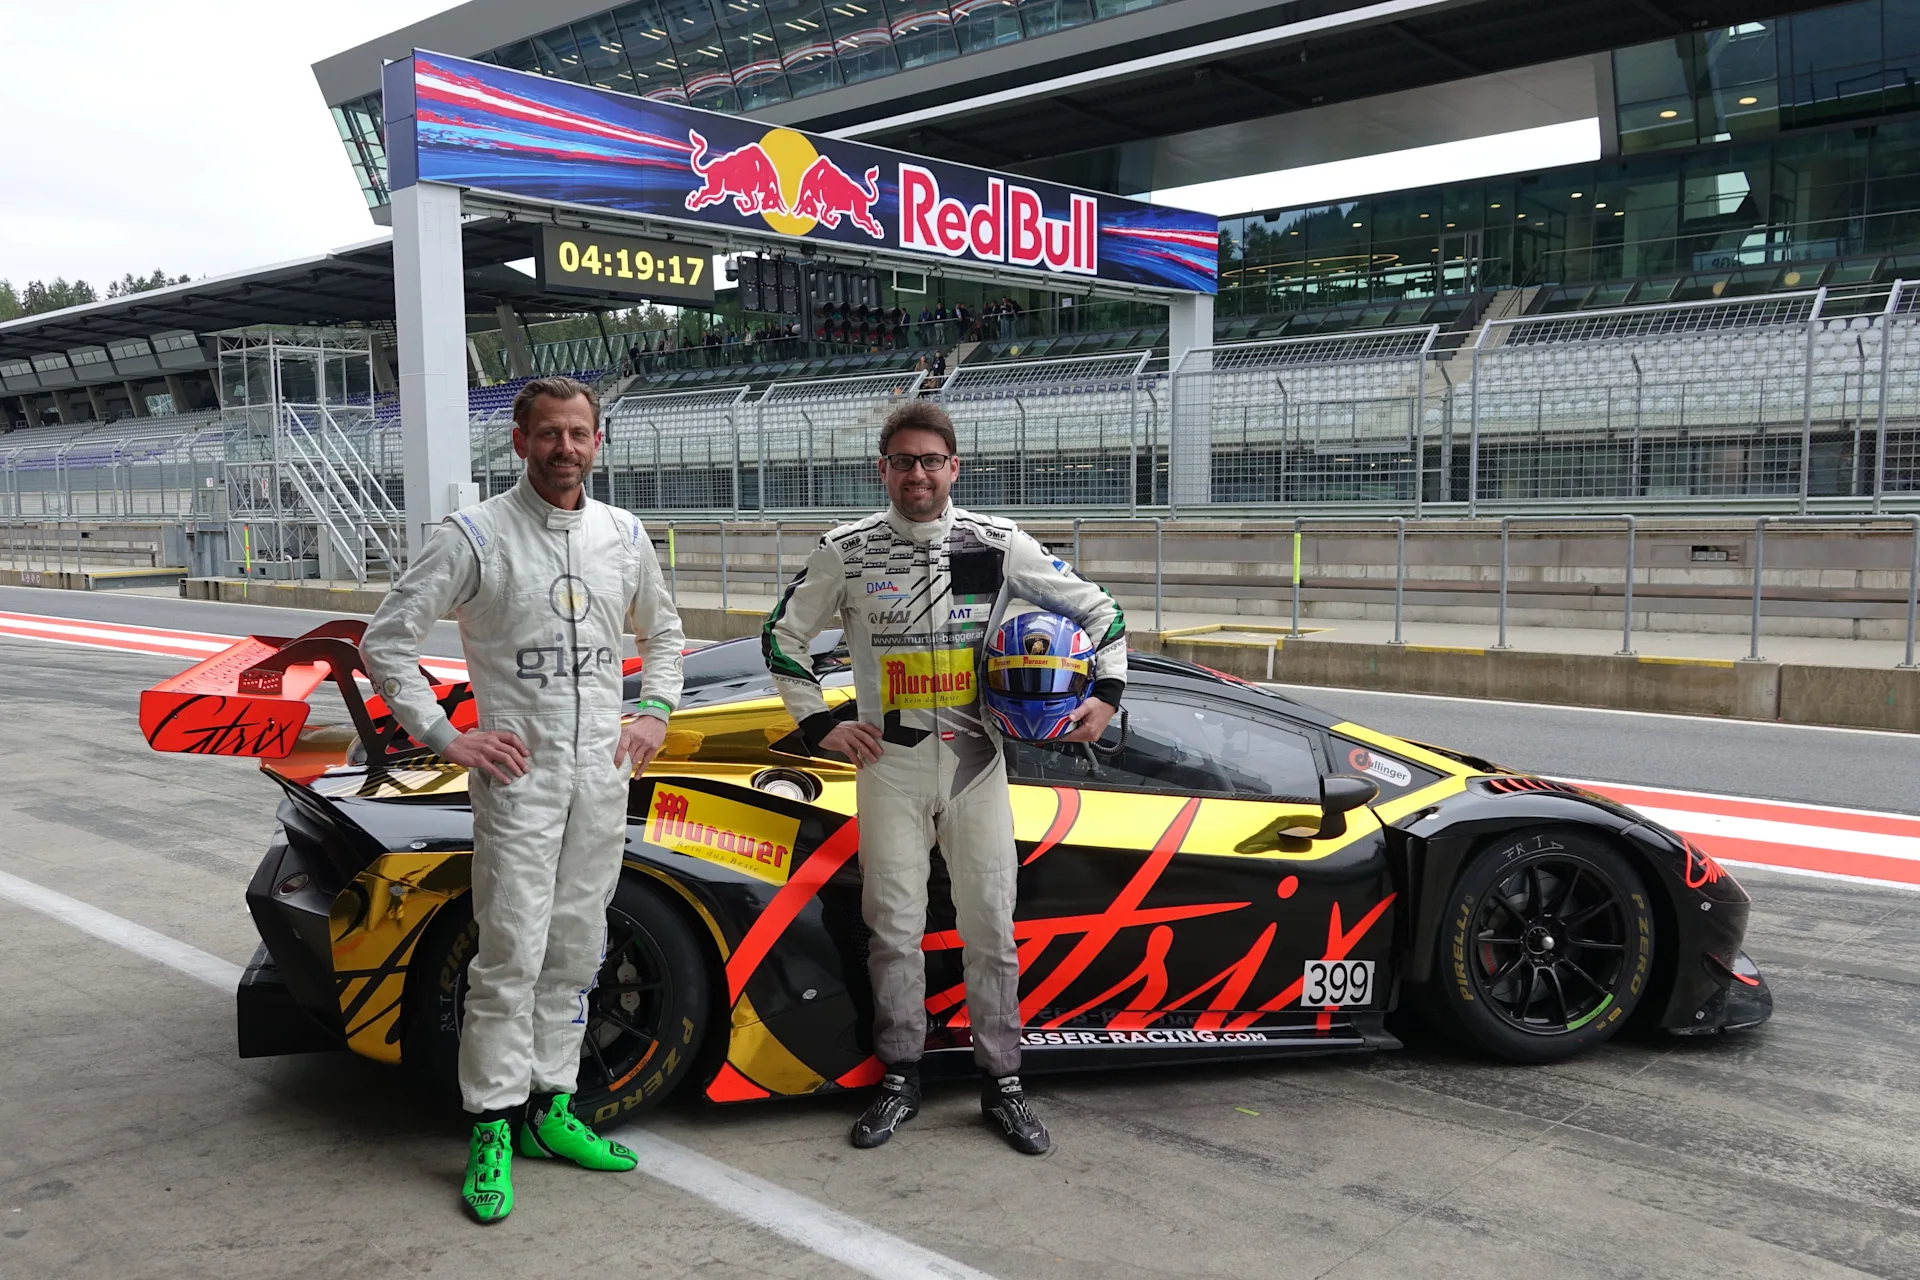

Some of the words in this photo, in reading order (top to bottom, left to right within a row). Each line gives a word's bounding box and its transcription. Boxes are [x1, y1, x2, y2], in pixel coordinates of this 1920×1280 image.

[899, 162, 1004, 262] Red
[1008, 185, 1098, 276] Bull
[558, 241, 705, 286] 04:19:17
[841, 537, 862, 551] OMP
[985, 529, 1007, 540] OMP
[872, 629, 985, 646] www.murtal-bagger.at
[886, 660, 973, 705] Murauer
[654, 791, 789, 869] Murauer
[676, 840, 702, 854] Rein
[706, 850, 726, 862] das
[729, 856, 760, 872] Beste
[1631, 893, 1645, 910] P
[1452, 903, 1475, 1001] PIRELLI
[1629, 916, 1649, 996] ZERO
[1308, 961, 1369, 1005] 399
[682, 1016, 695, 1045] P
[594, 1047, 681, 1124] ZERO
